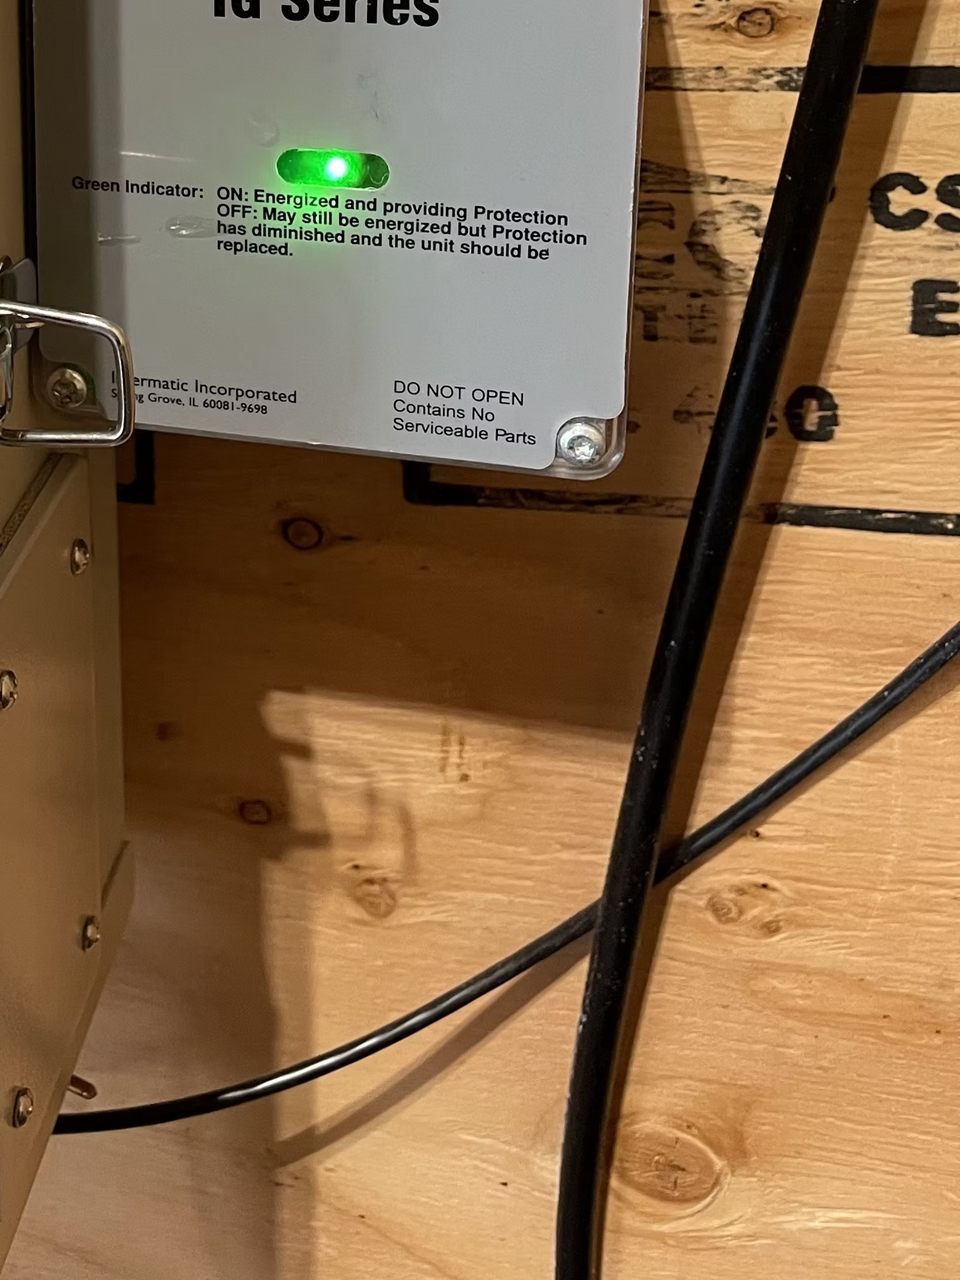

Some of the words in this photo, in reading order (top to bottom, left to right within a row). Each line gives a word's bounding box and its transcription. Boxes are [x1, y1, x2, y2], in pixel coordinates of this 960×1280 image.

[72, 176, 120, 193] Green
[125, 180, 204, 199] Indicator:
[217, 186, 249, 202] ON:
[254, 189, 339, 209] Energized
[344, 198, 377, 212] and
[383, 200, 467, 221] providing
[474, 205, 569, 226] Protection
[217, 203, 258, 219] OFF:
[263, 206, 296, 225] May
[301, 210, 332, 226] still
[338, 212, 360, 227] be
[364, 217, 452, 235] energized
[457, 221, 486, 238] but
[492, 224, 588, 246] Protection
[217, 220, 247, 236] has
[252, 223, 345, 243] diminished
[350, 231, 383, 247] and
[387, 234, 416, 249] the
[421, 238, 454, 253] unit
[460, 240, 522, 259] should
[527, 245, 550, 260] be
[217, 238, 293, 256] replaced.
[111, 370, 188, 392] Iermatic
[195, 379, 297, 403] Incorporated
[394, 380, 420, 395] DO
[427, 383, 466, 400] NOT
[471, 388, 524, 406] OPEN
[148, 392, 185, 407] Grove,
[189, 397, 199, 407] IL
[203, 398, 268, 415] 60081-9698
[393, 399, 465, 419] Contains
[471, 407, 495, 422] No
[393, 417, 488, 440] Serviceable
[495, 428, 536, 446] Parts
